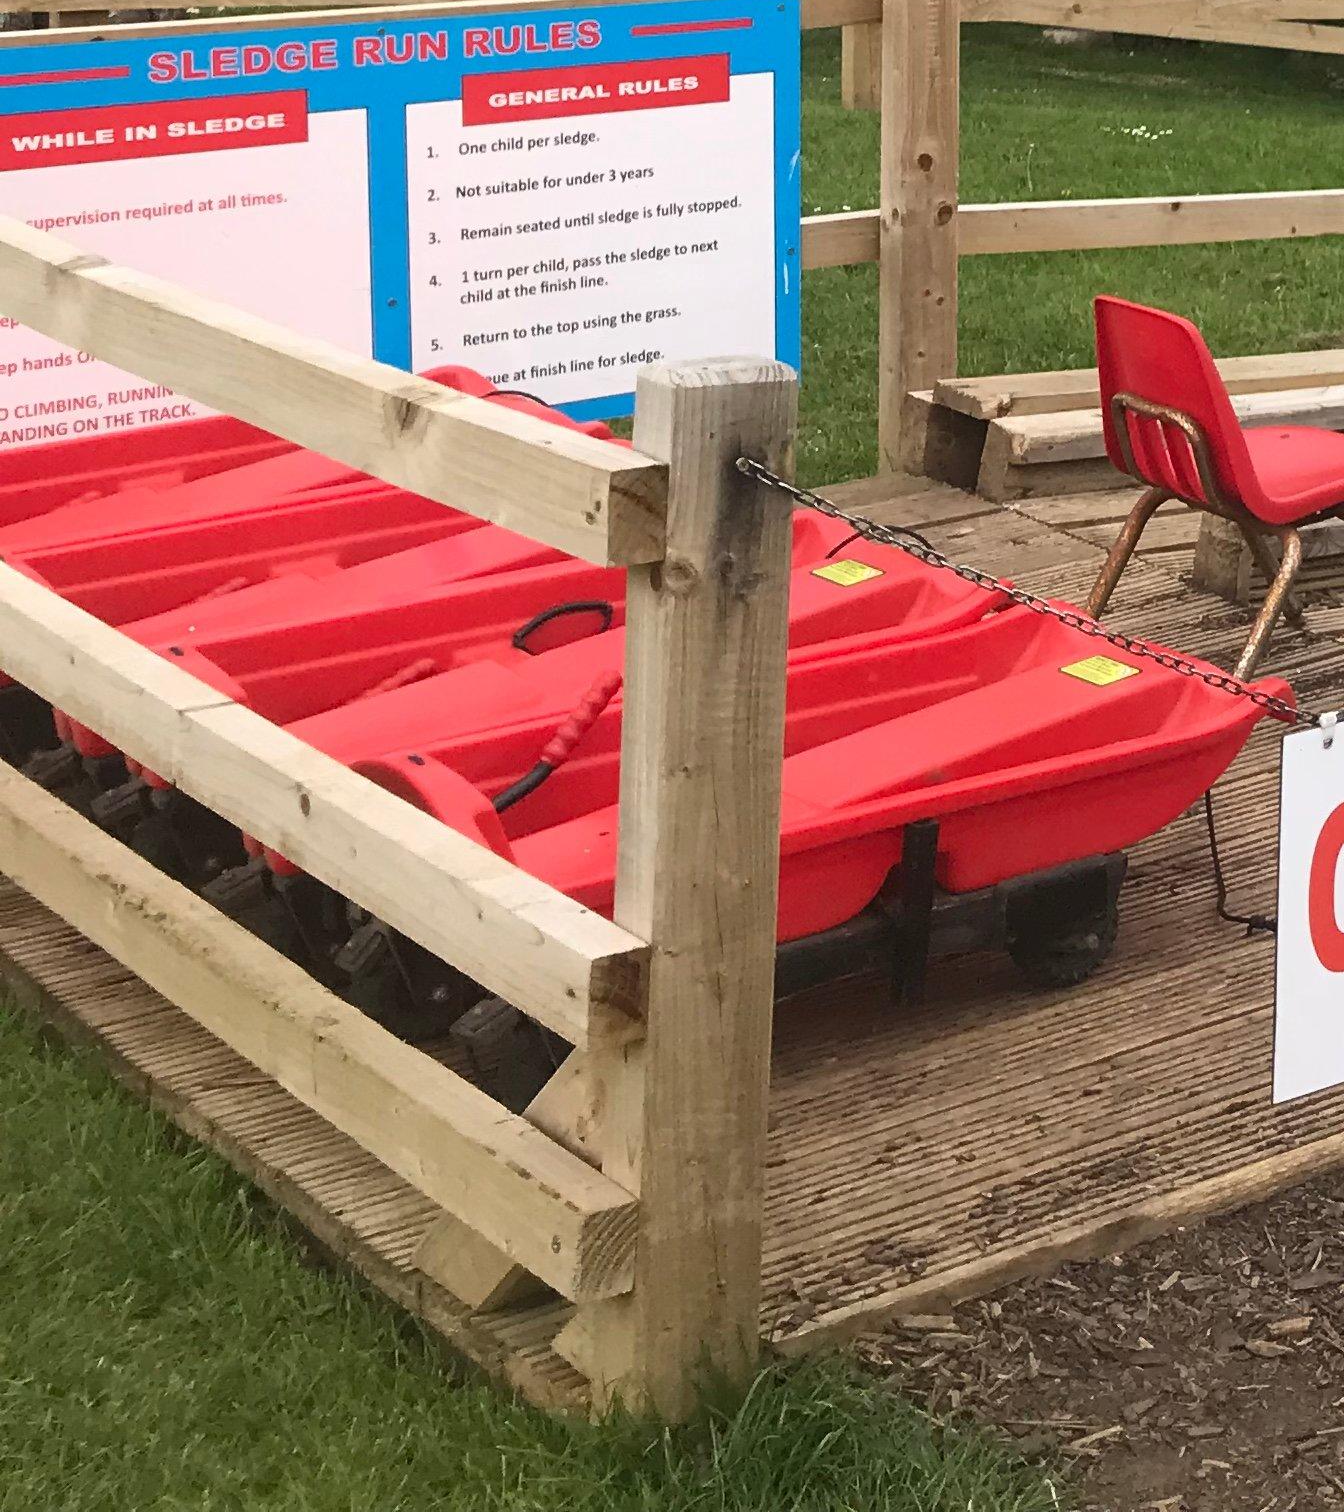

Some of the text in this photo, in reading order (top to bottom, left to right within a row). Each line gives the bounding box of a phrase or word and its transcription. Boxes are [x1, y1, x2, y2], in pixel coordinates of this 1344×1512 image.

[148, 20, 601, 83] SLEDGE RUN RULES
[488, 76, 699, 108] GENERAL RULES
[12, 113, 286, 152] WHILE IN SLEDGE
[427, 131, 600, 159] 1. One child per sledge.
[427, 167, 654, 202] 2. Not suitable for under 3 years
[126, 199, 193, 221] required
[199, 199, 214, 211] at
[218, 195, 236, 210] all
[240, 191, 288, 207] times.
[428, 195, 742, 245] 3. Remain seated until sledge is fully stopped.
[429, 240, 719, 287] 4. 1 turn per child, pass the sledge to next
[460, 276, 609, 305] child at the finish line.
[431, 307, 681, 352] 5. Return to the top using the grass.
[23, 352, 72, 370] hands
[513, 369, 526, 381] at
[530, 363, 566, 378] finish
[570, 359, 594, 373] line
[598, 355, 617, 368] for
[620, 349, 664, 364] sledge.
[108, 385, 173, 405] RUNNIN
[0, 403, 196, 444] ANDING ON THE TRACK.
